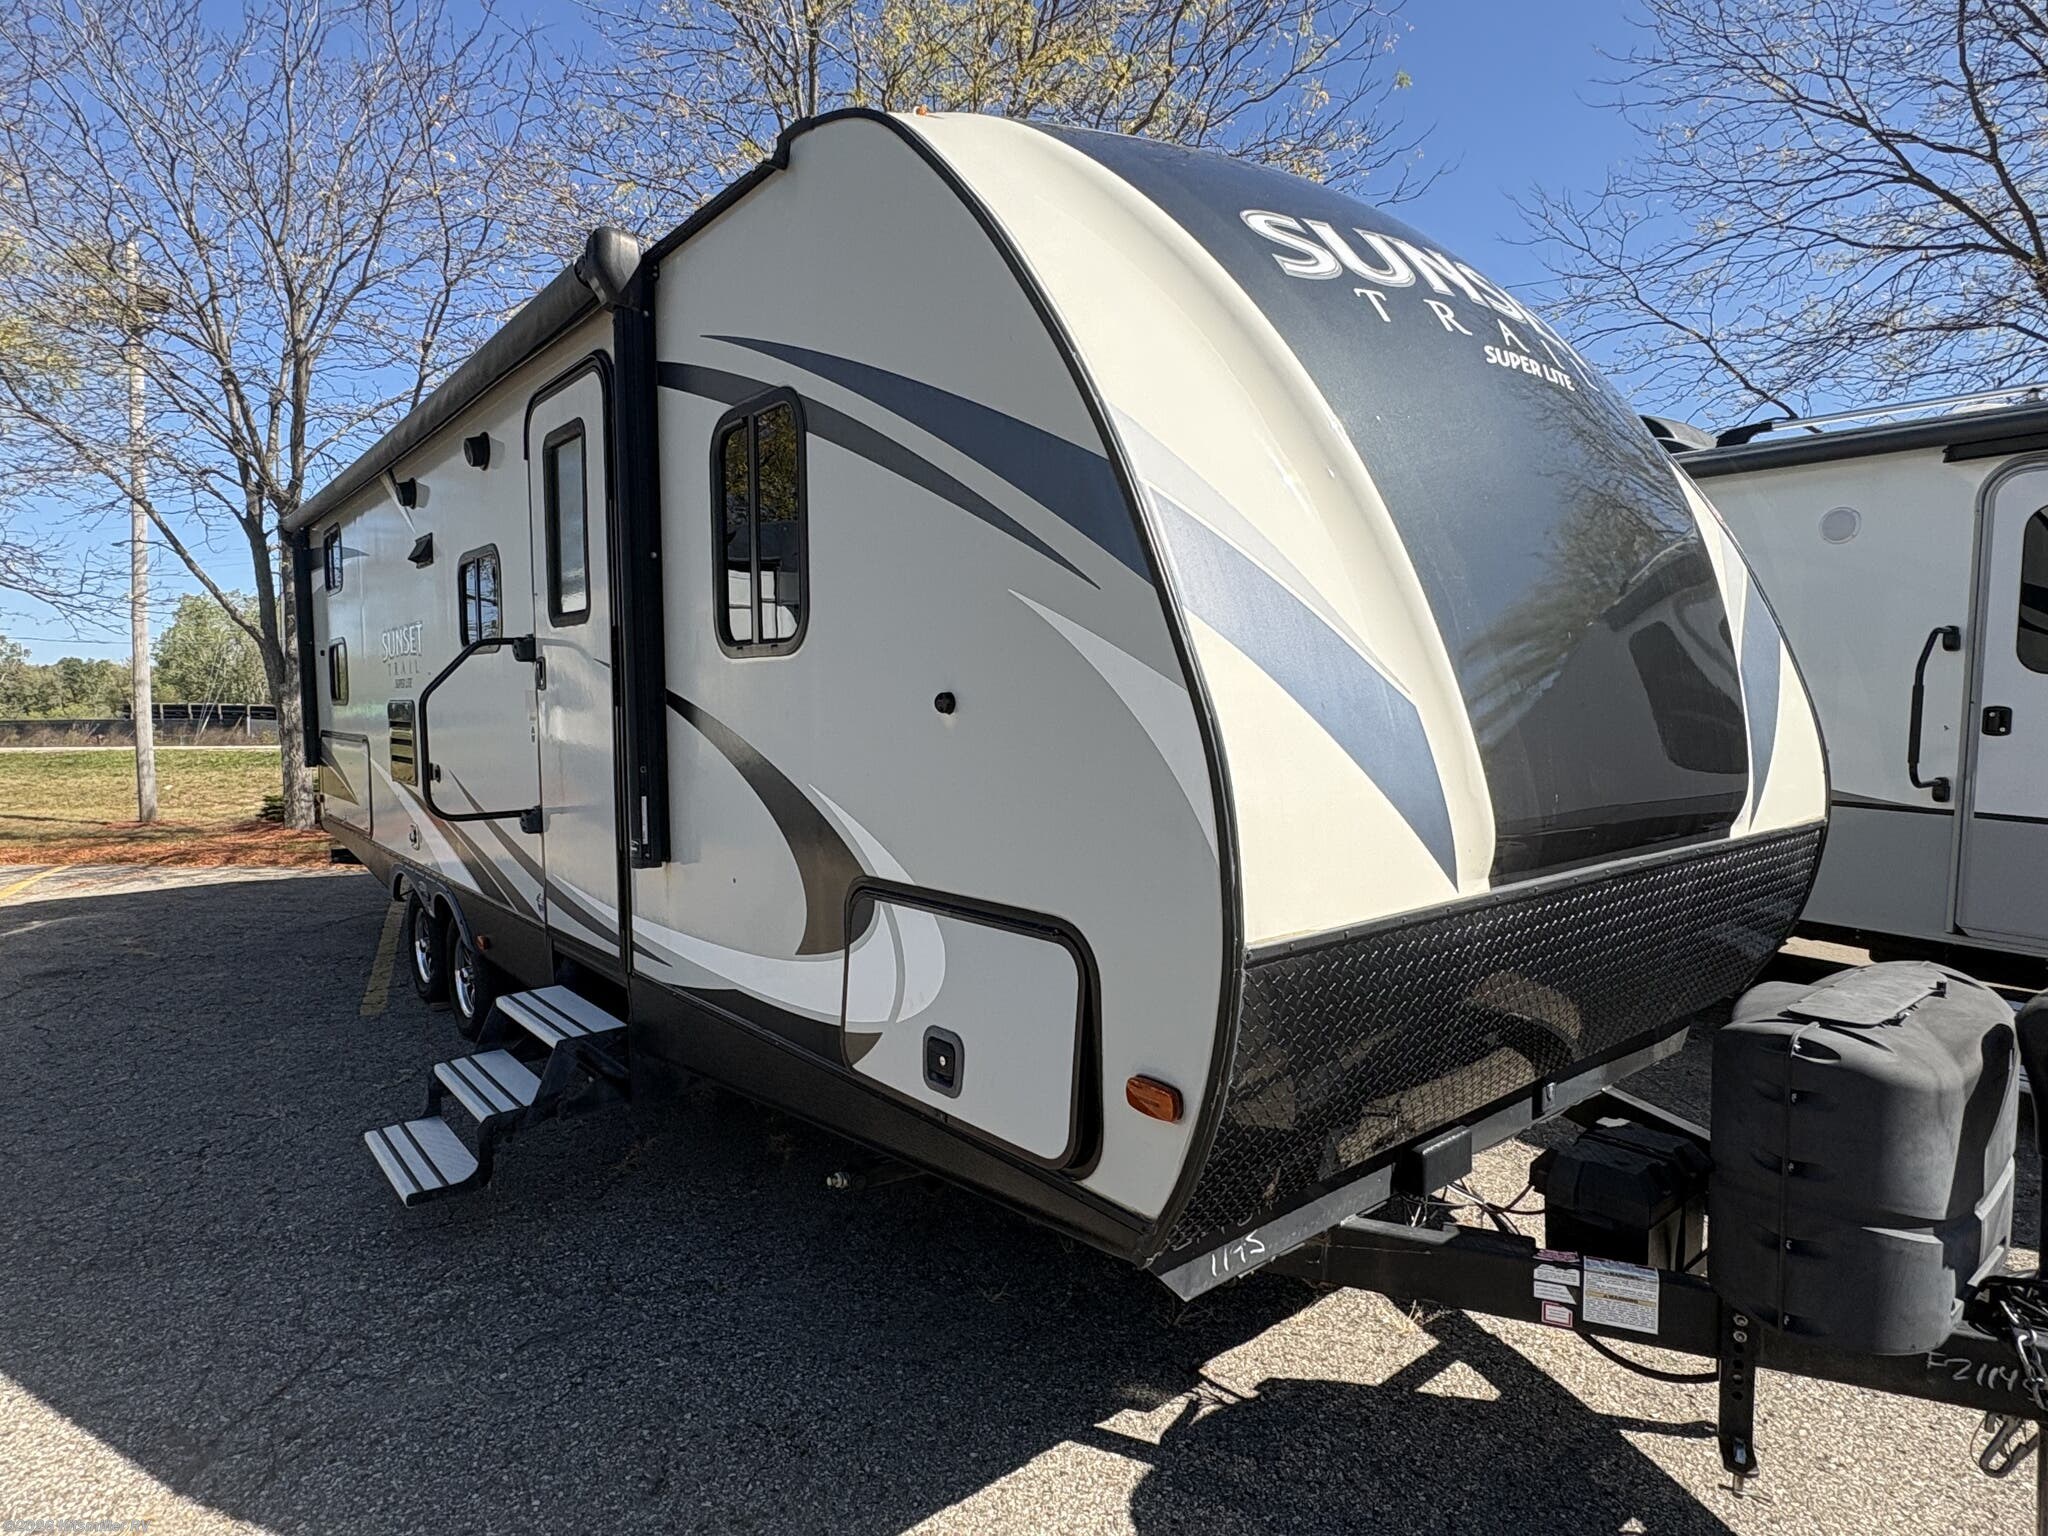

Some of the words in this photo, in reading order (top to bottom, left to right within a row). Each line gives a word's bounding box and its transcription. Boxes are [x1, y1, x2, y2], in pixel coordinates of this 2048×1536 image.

[1484, 344, 1543, 378] SUPER
[1541, 363, 1576, 392] LITE
[382, 621, 423, 662] SUNSET
